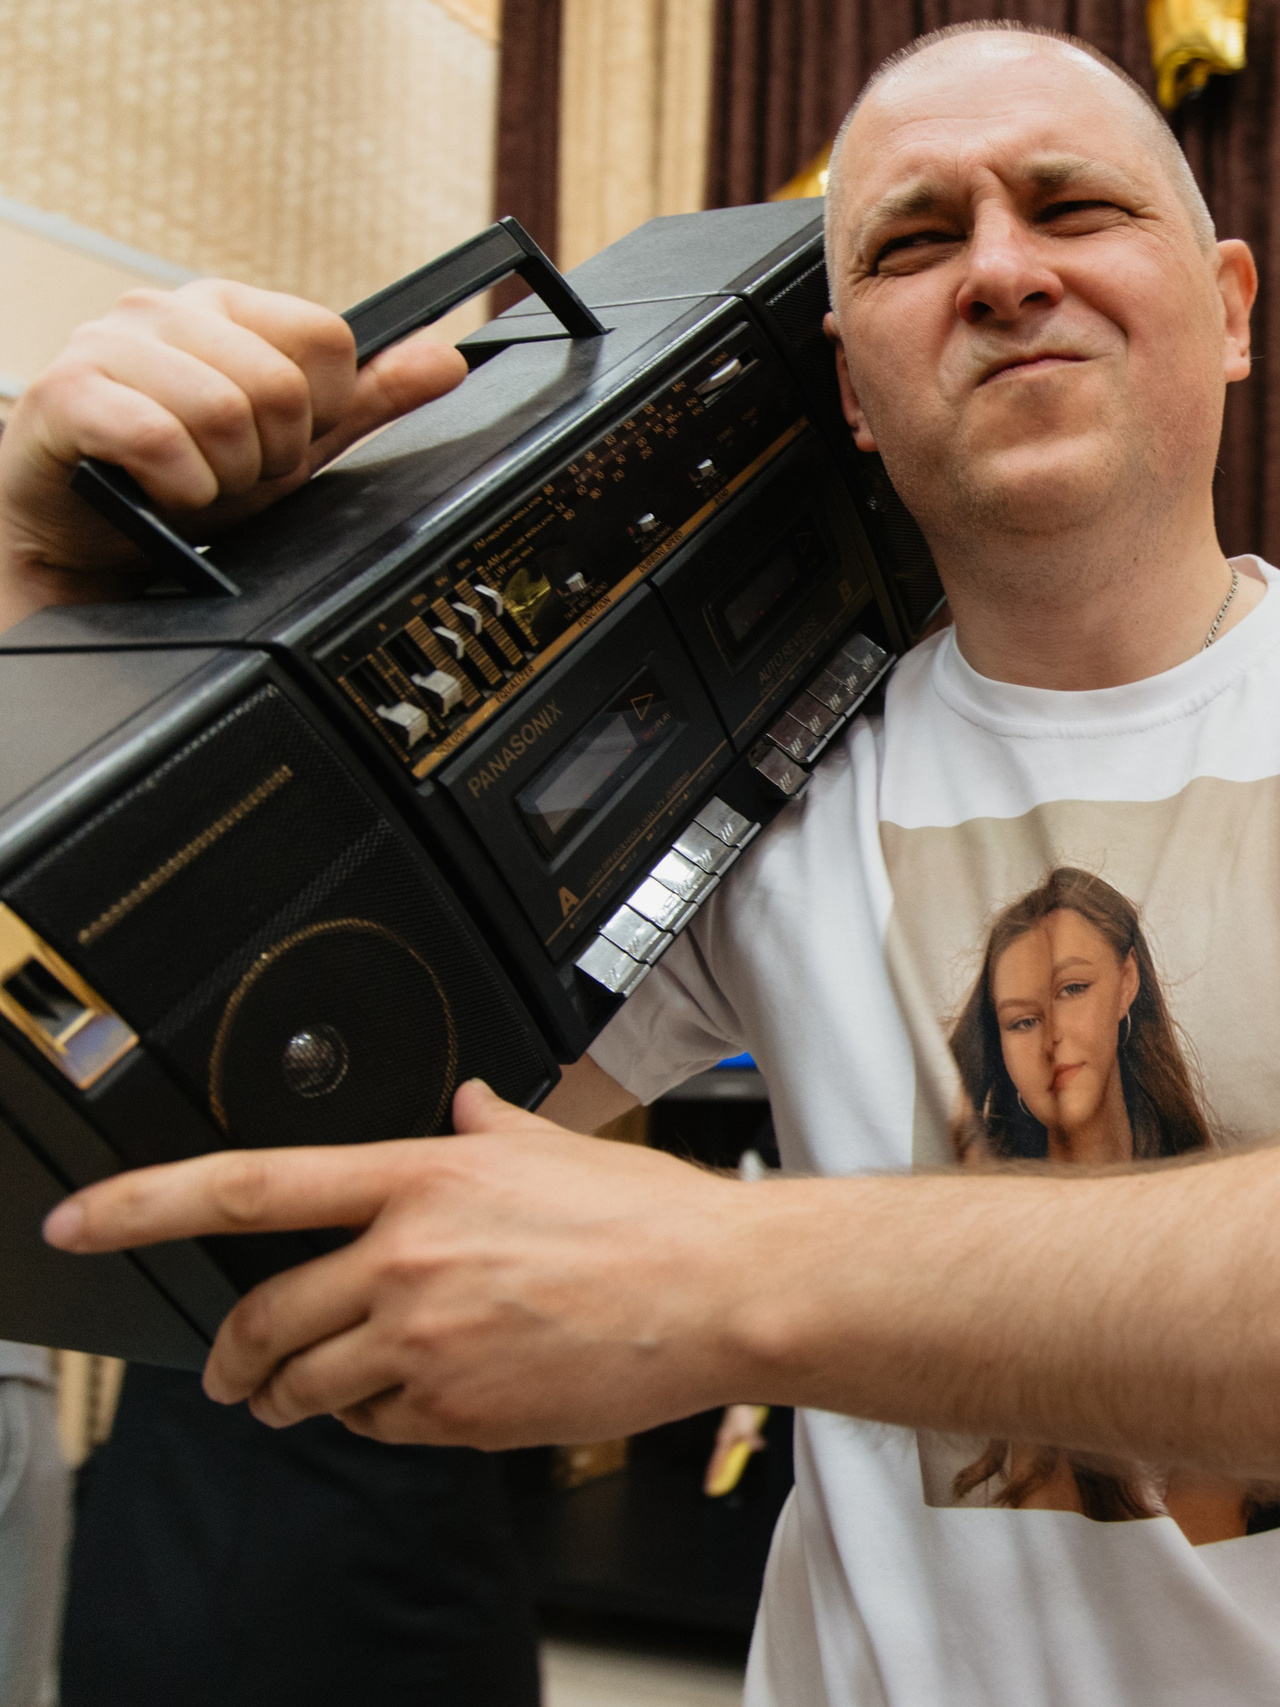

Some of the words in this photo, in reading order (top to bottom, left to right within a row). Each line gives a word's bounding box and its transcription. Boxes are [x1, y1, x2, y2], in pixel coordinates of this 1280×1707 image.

[471, 536, 488, 553] FM
[540, 481, 557, 497] 88
[484, 552, 502, 569] AM
[492, 562, 509, 579] LW
[576, 594, 612, 629] FUNCTION
[493, 663, 535, 703] EQUALIZER
[758, 651, 784, 685] AUTO
[465, 698, 563, 800] PANASONIX
[559, 884, 581, 918] A
